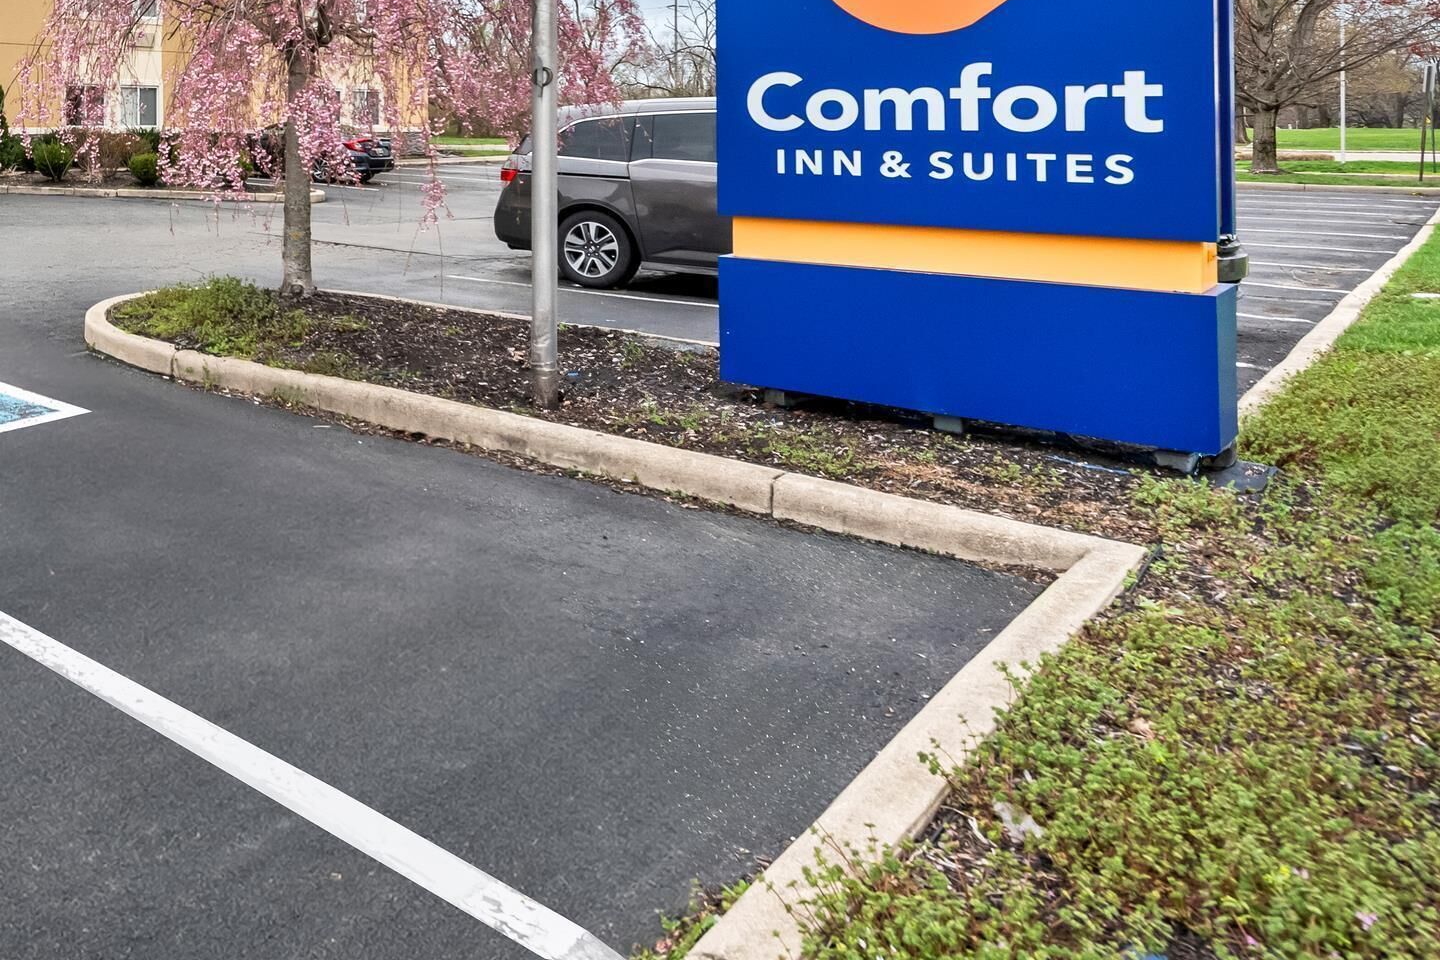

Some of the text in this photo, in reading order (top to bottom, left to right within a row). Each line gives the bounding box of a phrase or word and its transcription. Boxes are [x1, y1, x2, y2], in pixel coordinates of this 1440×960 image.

[746, 62, 1164, 133] Comfort
[776, 149, 1134, 185] INN & SUITES
